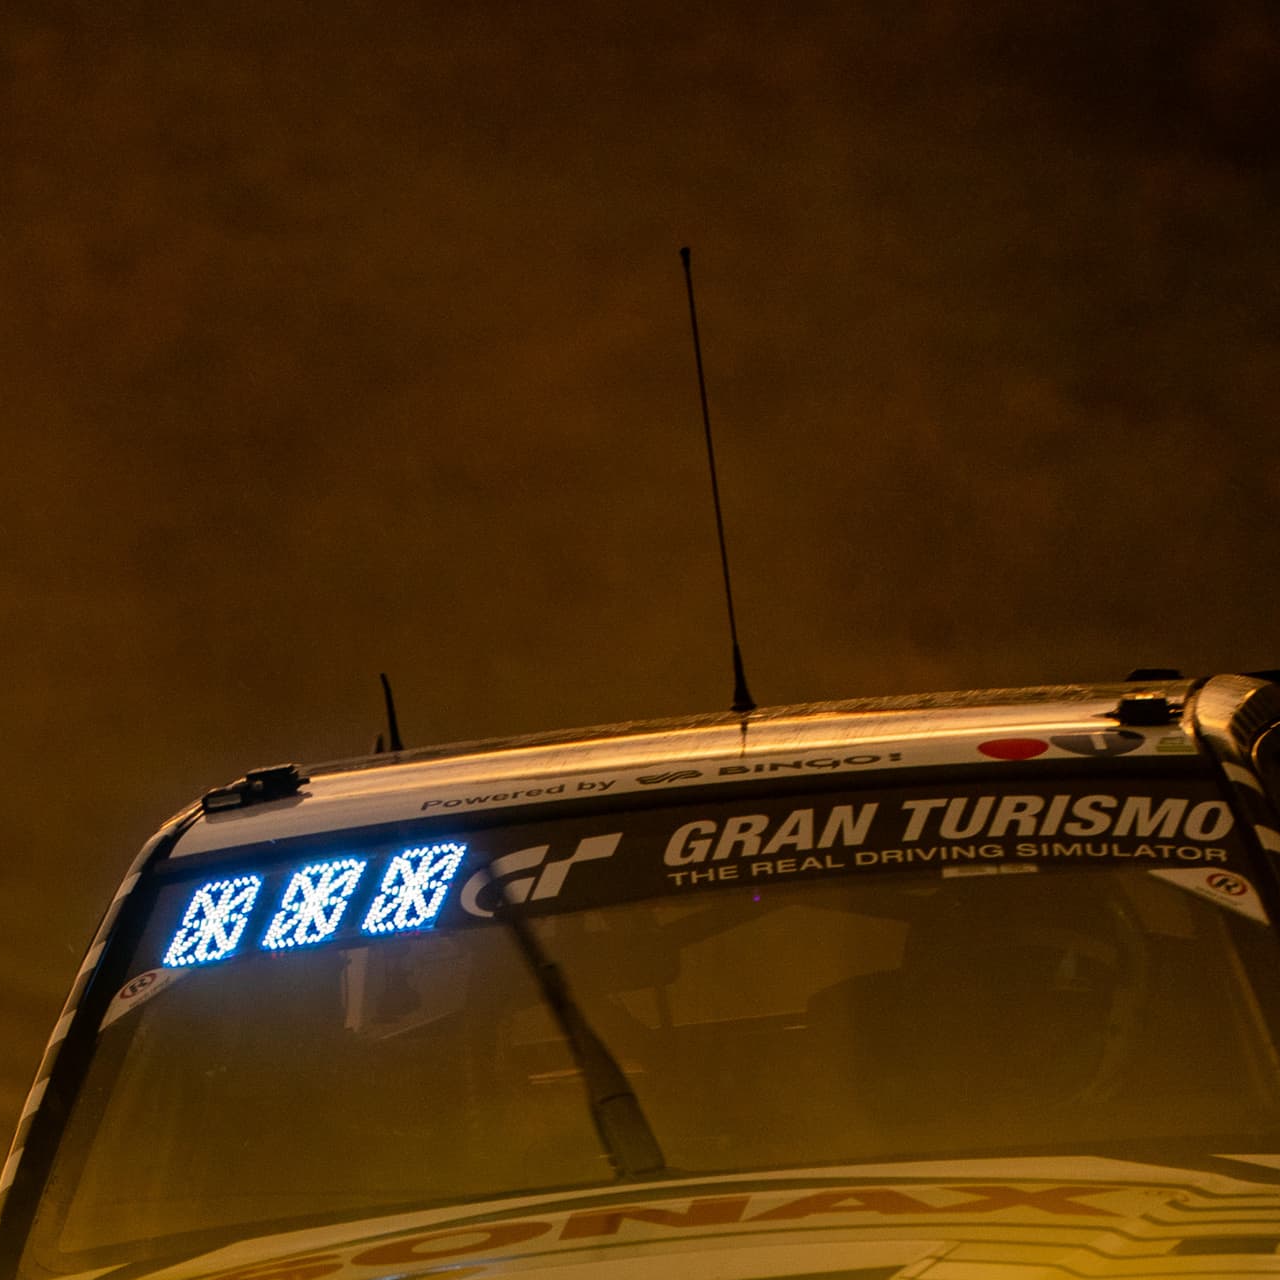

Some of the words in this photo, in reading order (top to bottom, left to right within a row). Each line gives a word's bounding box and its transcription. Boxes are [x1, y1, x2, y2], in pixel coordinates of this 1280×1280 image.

[420, 784, 565, 811] Powered
[577, 779, 616, 793] by
[663, 802, 880, 867] GRAN
[901, 794, 1235, 842] TURISMO
[667, 864, 740, 886] THE
[751, 854, 845, 877] REAL
[855, 843, 1006, 866] DRIVING
[1015, 842, 1228, 863] SIMULATOR
